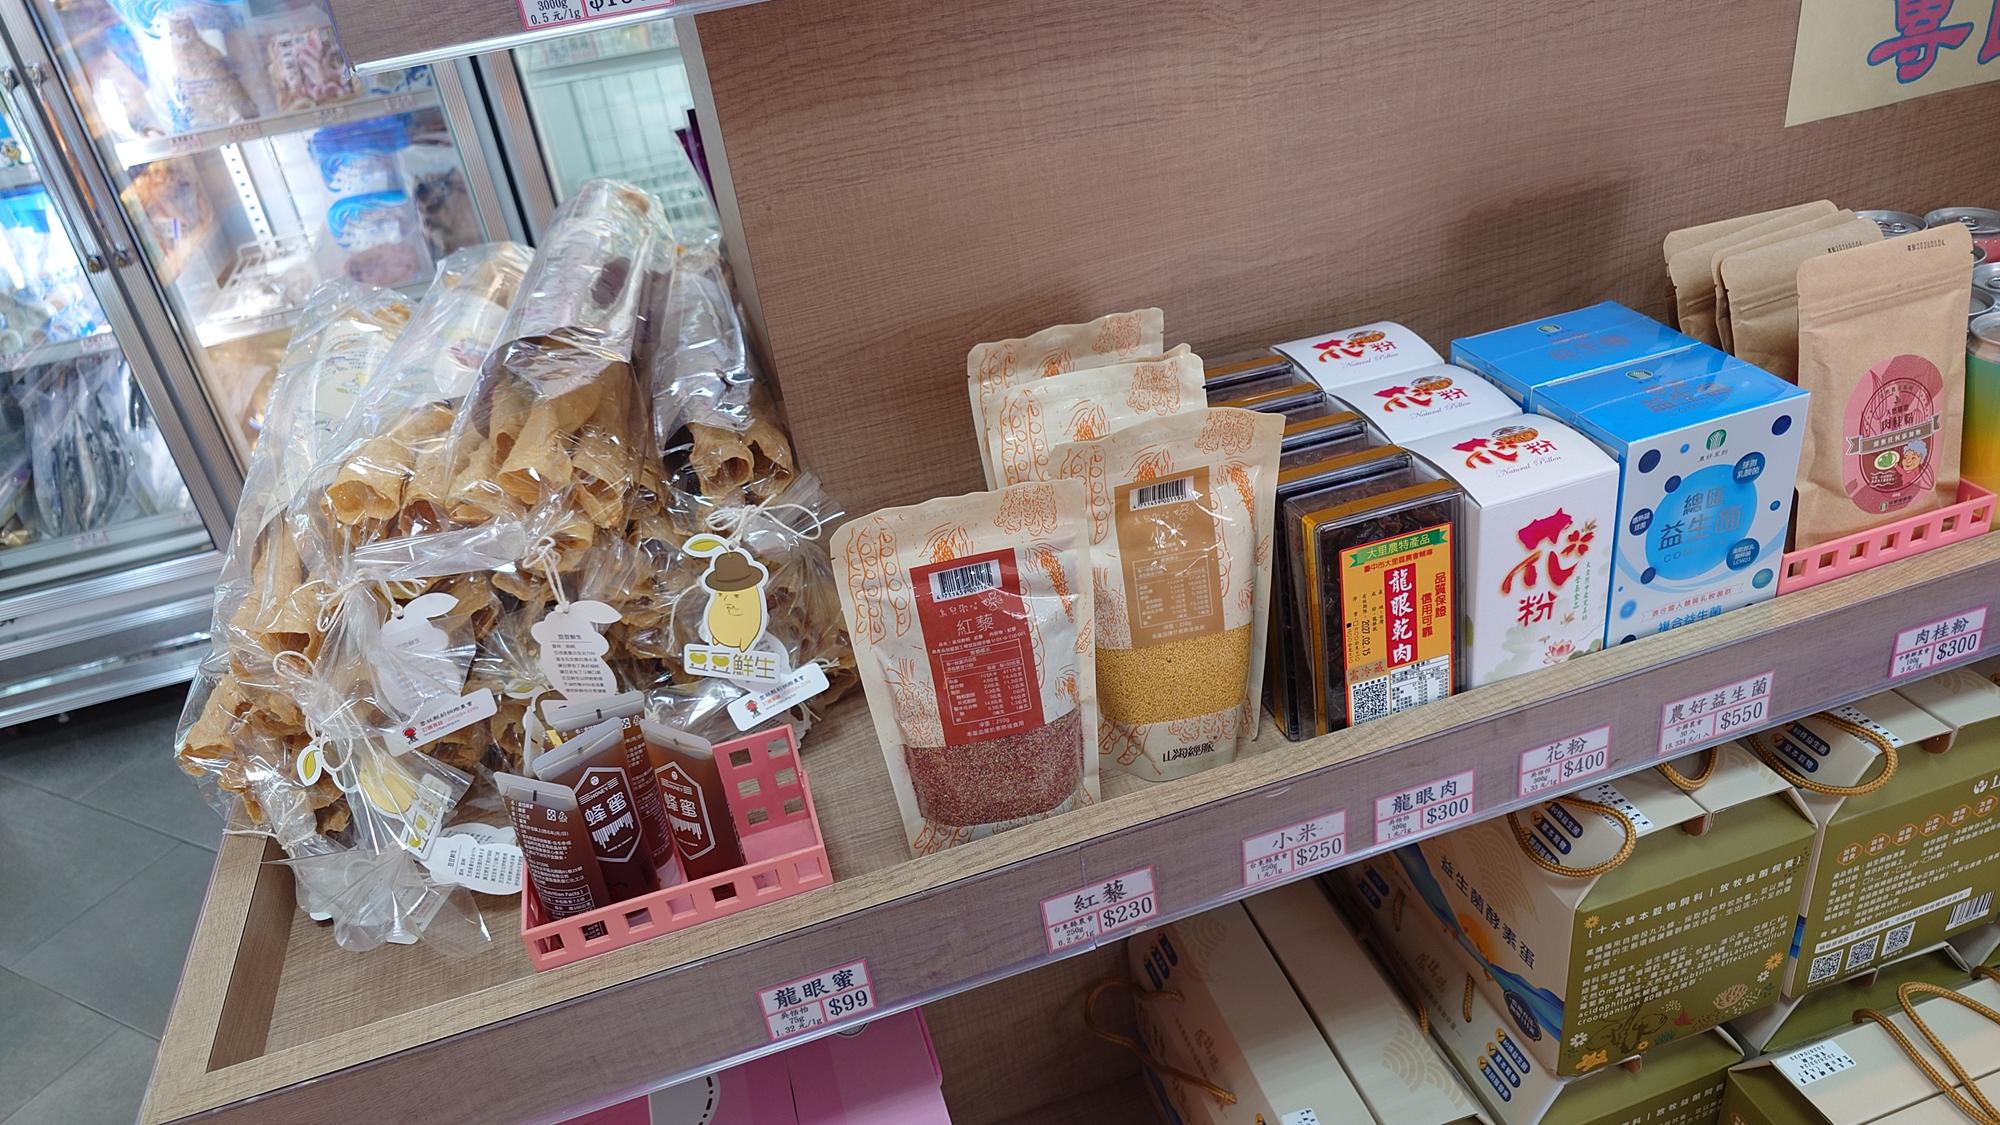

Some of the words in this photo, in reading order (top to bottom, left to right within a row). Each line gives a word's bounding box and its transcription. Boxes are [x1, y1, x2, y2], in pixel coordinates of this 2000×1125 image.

[1496, 462, 1531, 477] Natural
[1533, 454, 1562, 468] Pollen
[1367, 533, 1431, 559] 大里農特產品
[956, 613, 995, 637] 紅藜
[1388, 568, 1413, 663] 龍眼乾肉
[1915, 617, 1969, 646] 肉桂粉
[1936, 633, 1977, 661] $300
[1668, 676, 1768, 724] 農好益生菌
[1720, 701, 1763, 731] $550
[1545, 737, 1588, 763] 花粉
[1563, 751, 1605, 778] $400
[584, 791, 627, 827] 蜂蜜
[1391, 780, 1457, 815] 龍眼肉
[1426, 797, 1469, 825] $300
[1271, 823, 1317, 850] 小米
[1296, 837, 1342, 866] $250
[1073, 879, 1128, 914] 紅藜
[1102, 896, 1153, 929] $230
[1440, 855, 1536, 971] 益生菌酵素蛋
[773, 969, 855, 1010] 龍眼蜜
[828, 989, 869, 1017] $99
